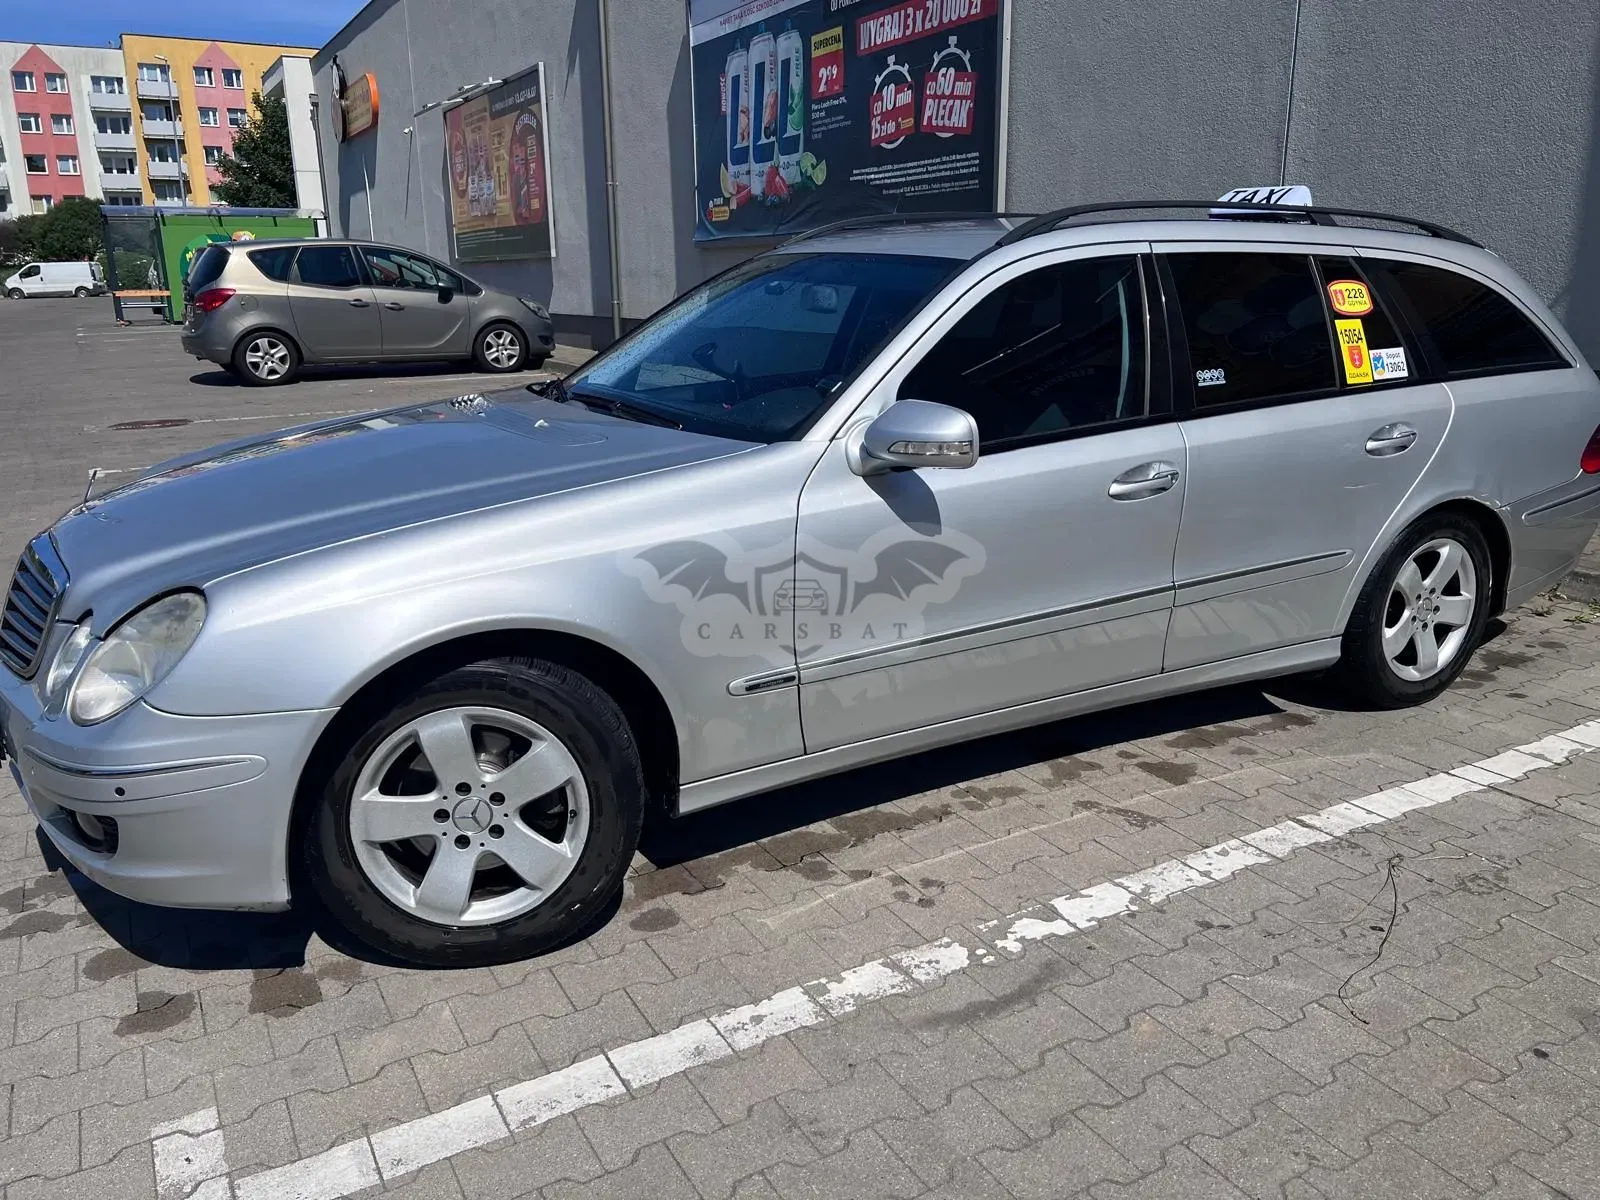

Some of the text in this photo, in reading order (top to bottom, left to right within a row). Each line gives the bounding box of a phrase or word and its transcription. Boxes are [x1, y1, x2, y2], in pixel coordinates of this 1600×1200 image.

[860, 9, 905, 50] WYGRAJ
[905, 7, 914, 36] 3
[924, 0, 941, 30] 20
[813, 34, 841, 52] SUPERCENA
[926, 67, 972, 96] co 60 min
[874, 83, 912, 115] co 10 min
[871, 115, 881, 140] 15
[1228, 187, 1294, 205] TAXI
[1345, 288, 1365, 299] 228
[1340, 328, 1363, 345] 15054
[1386, 361, 1406, 373] 13062
